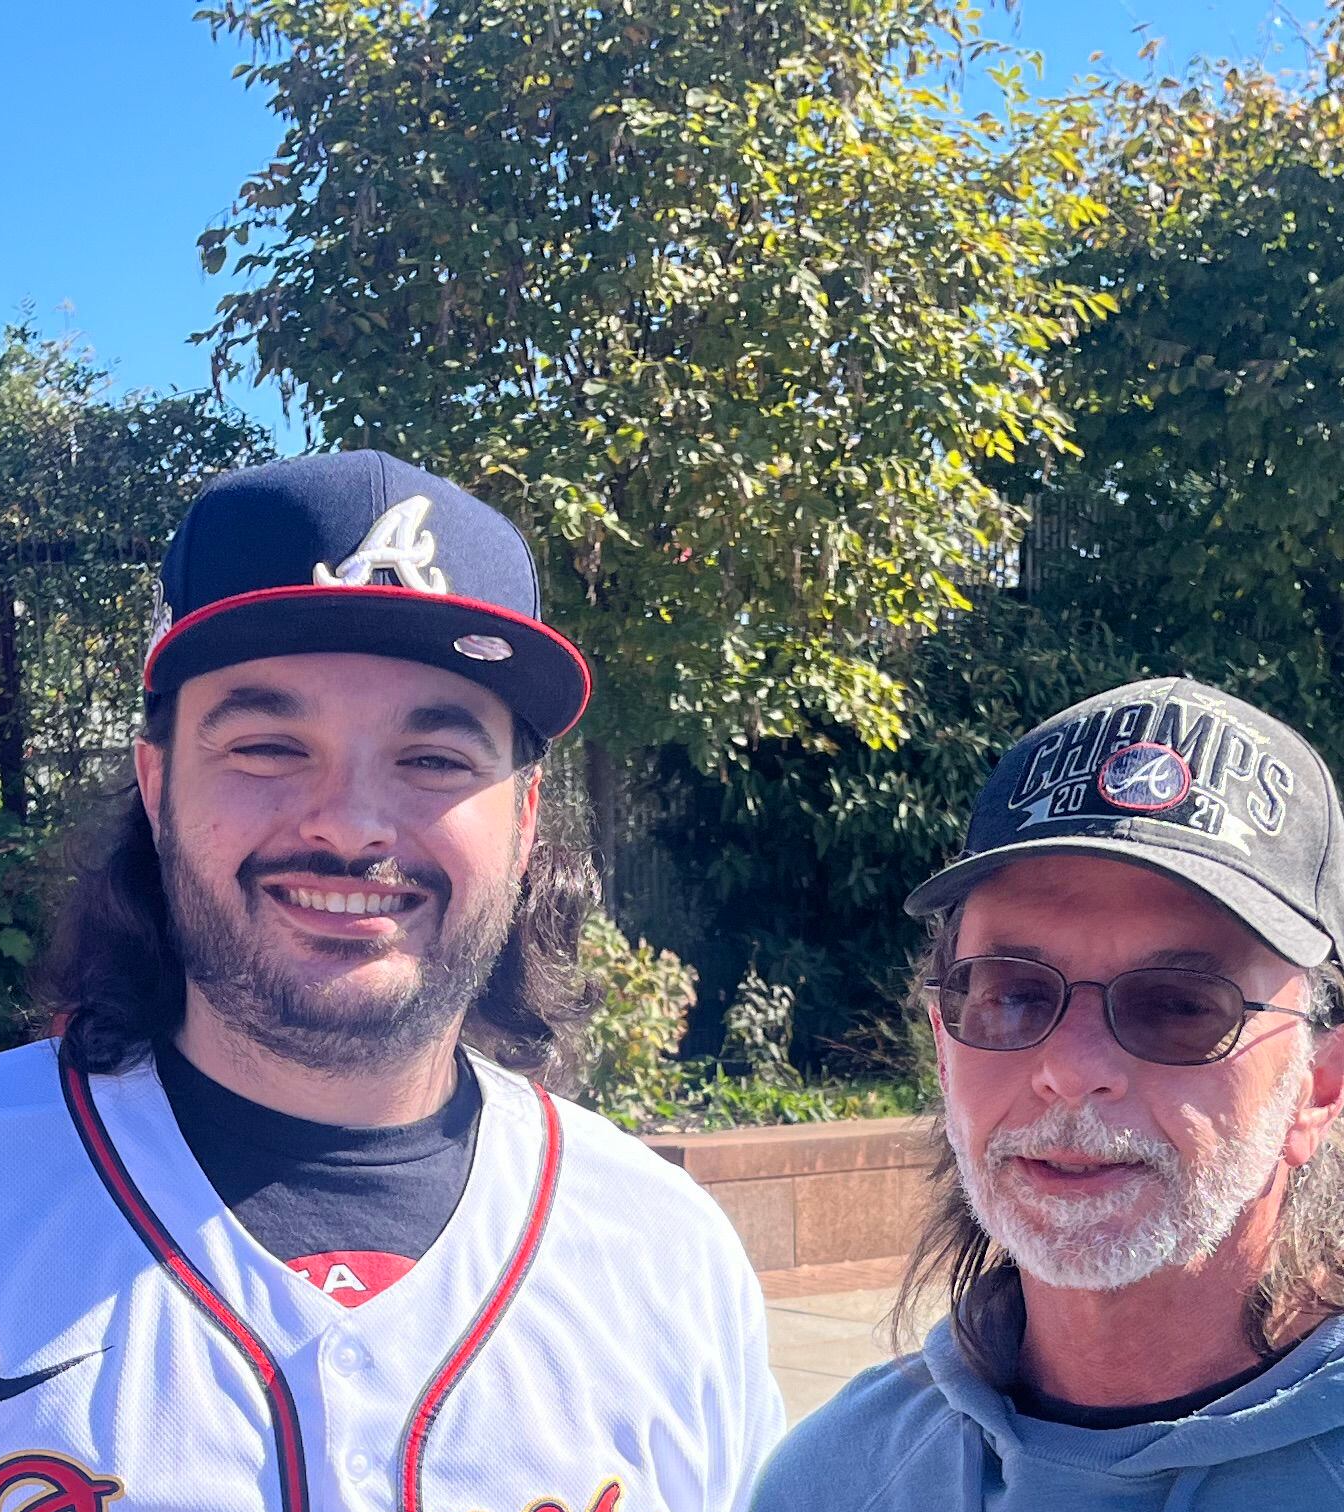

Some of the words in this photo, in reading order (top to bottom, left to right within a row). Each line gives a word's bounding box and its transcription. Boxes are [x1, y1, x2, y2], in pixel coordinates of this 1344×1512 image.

[312, 494, 448, 595] A
[1008, 694, 1295, 837] CHAMPS
[1053, 783, 1088, 815] 20
[1188, 795, 1222, 834] 21
